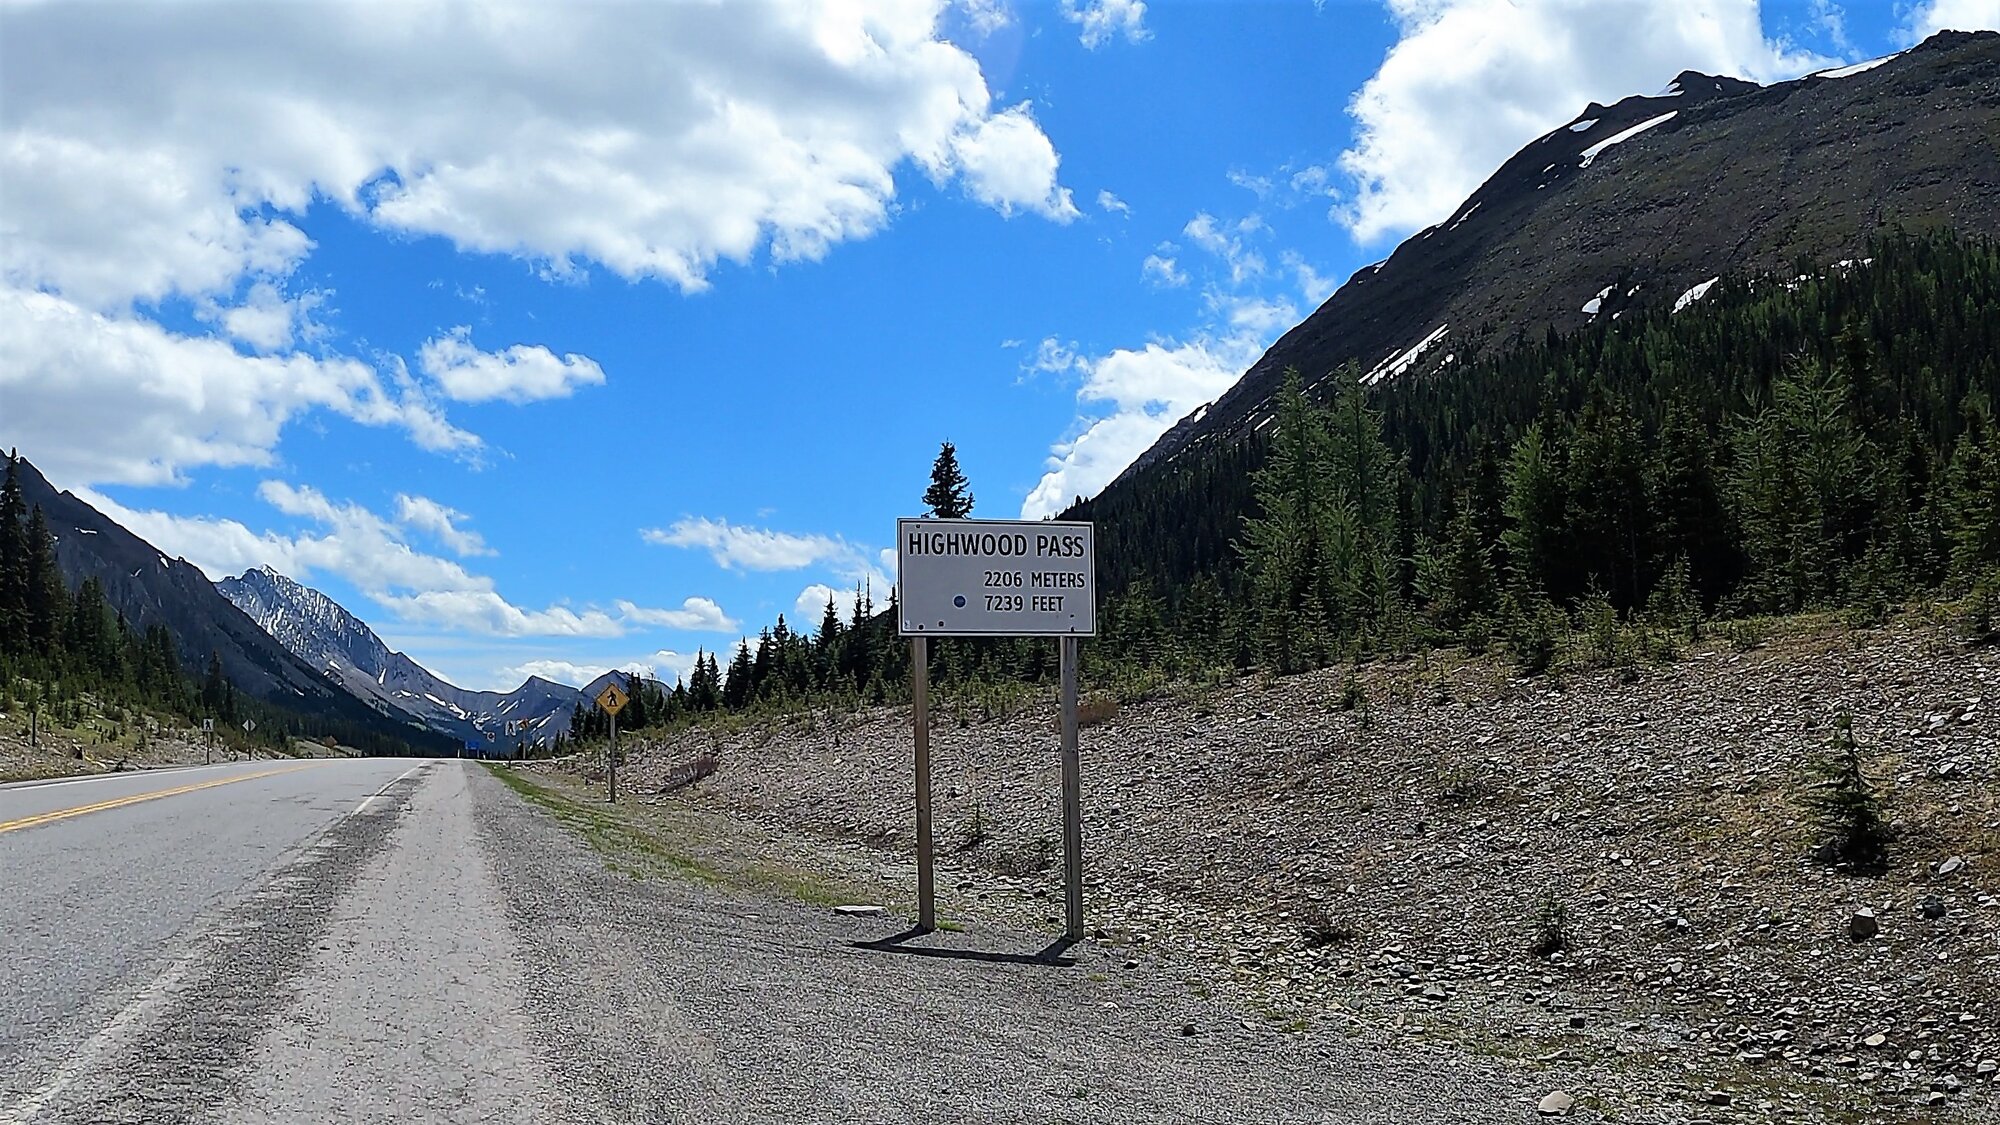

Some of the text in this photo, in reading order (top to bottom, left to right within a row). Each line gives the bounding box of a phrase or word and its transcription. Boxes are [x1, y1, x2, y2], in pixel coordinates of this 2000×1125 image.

[909, 533, 1084, 557] HIGHWOOD PASS
[984, 571, 1085, 588] 2206 METERS
[984, 595, 1065, 611] 7239 FEET
